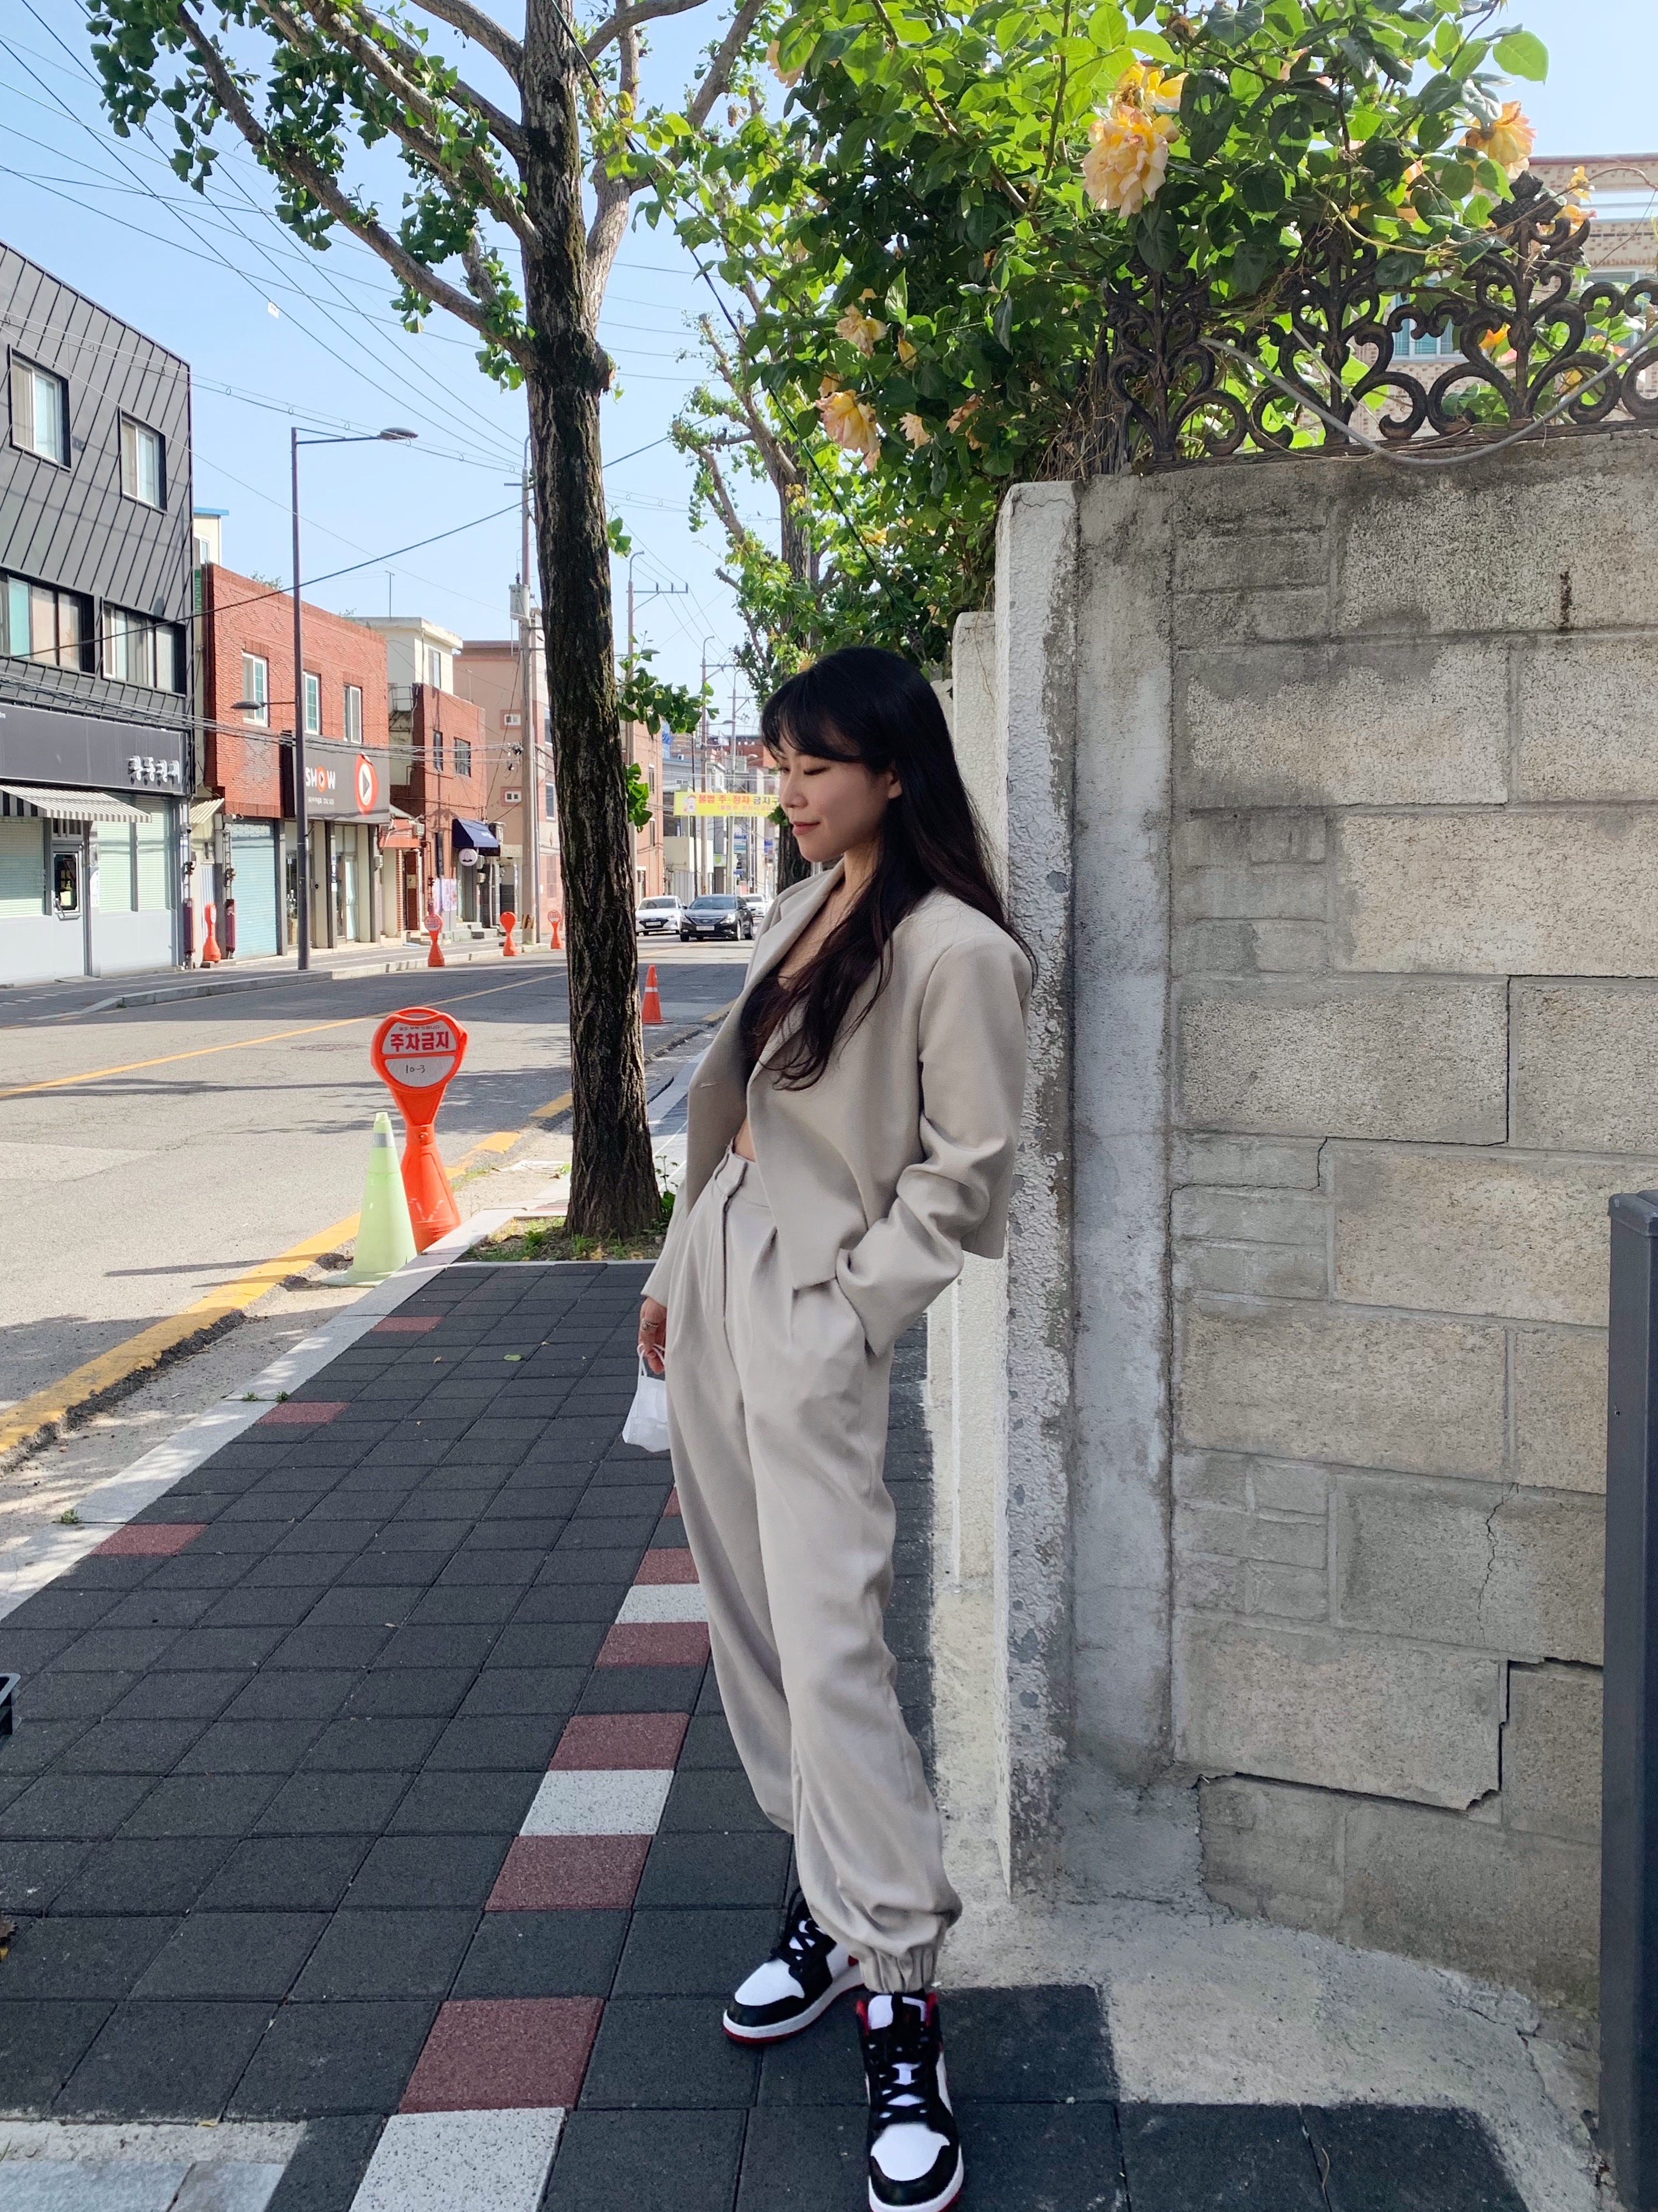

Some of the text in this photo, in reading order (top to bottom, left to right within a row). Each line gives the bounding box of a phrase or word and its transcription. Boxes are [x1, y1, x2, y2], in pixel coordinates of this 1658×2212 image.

[305, 765, 336, 792] SHOW
[699, 794, 715, 804] 불법
[390, 1031, 449, 1052] 주차금지
[405, 1064, 425, 1074] 10-3
